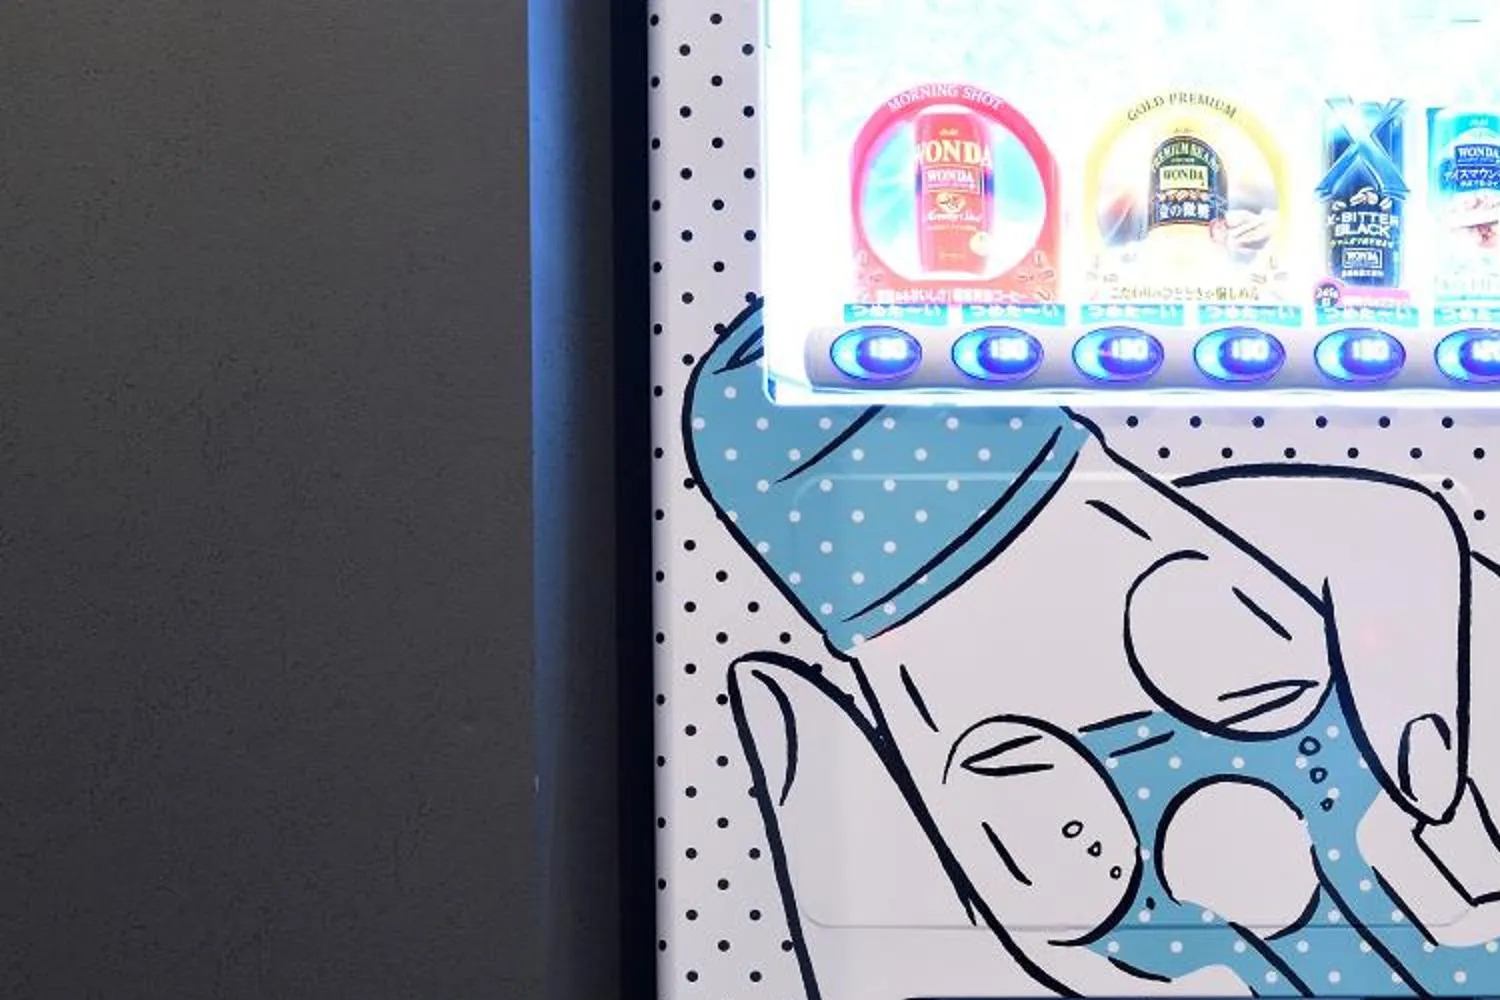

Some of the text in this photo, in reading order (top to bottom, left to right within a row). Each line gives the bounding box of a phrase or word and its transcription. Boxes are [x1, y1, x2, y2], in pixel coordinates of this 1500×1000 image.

[887, 85, 1004, 110] MORNING SHOT
[1128, 92, 1237, 121] GOLD PREMIUM
[1457, 147, 1500, 158] WONDA
[927, 169, 973, 183] WONDA
[1163, 169, 1205, 181] WONDA
[1334, 224, 1393, 237] BLACK
